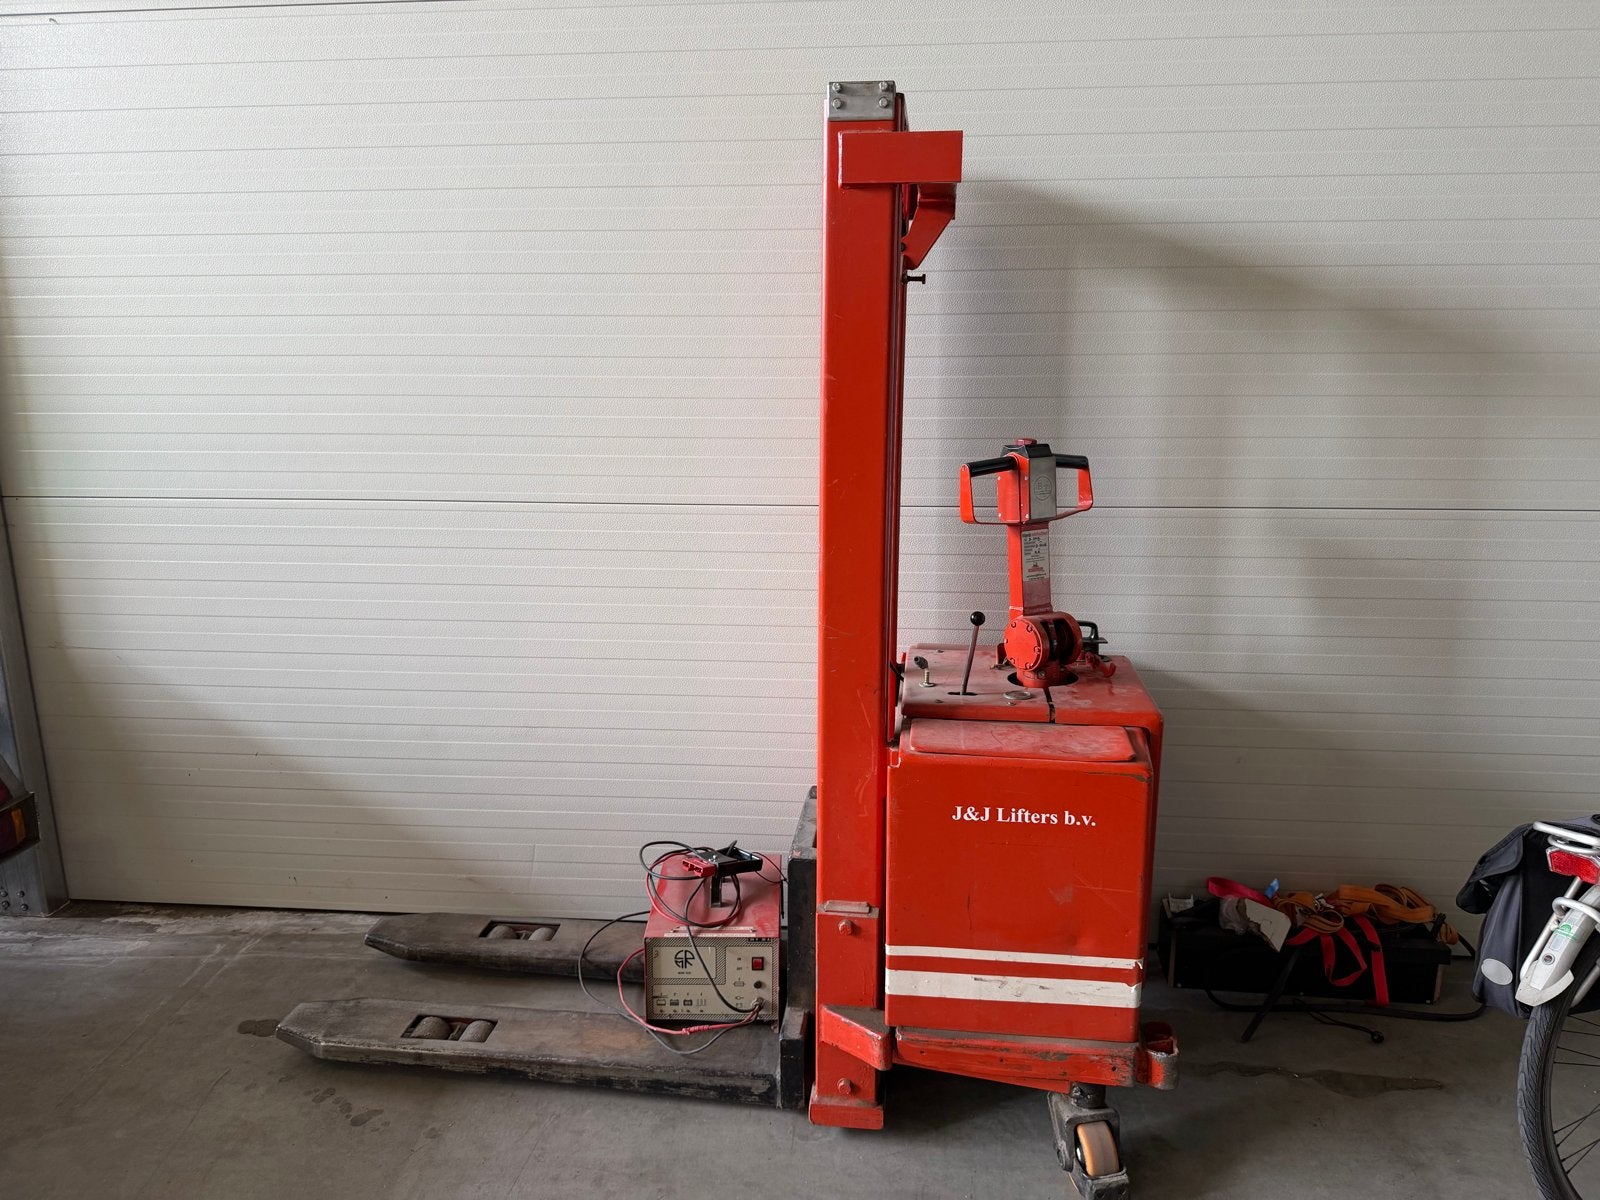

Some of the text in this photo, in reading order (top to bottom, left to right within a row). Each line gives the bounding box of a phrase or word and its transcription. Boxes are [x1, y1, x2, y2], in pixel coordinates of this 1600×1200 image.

[952, 805, 1096, 827] J&J Lifters b.v.
